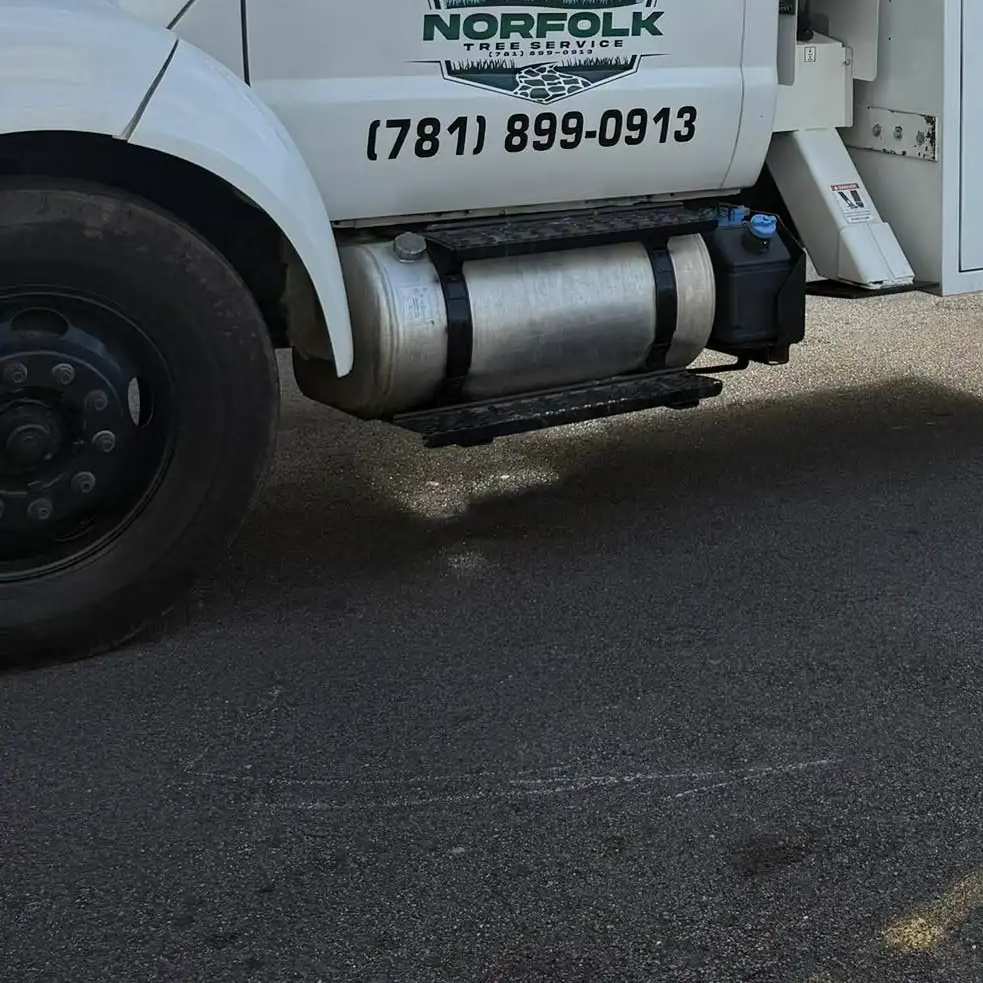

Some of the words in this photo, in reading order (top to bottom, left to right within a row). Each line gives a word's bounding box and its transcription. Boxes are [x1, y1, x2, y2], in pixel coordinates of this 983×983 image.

[422, 11, 664, 42] NORFOLK
[463, 41, 521, 52] TREE
[530, 39, 624, 50] SERVICE
[366, 114, 487, 161] (781)
[504, 105, 697, 153] 899-0913
